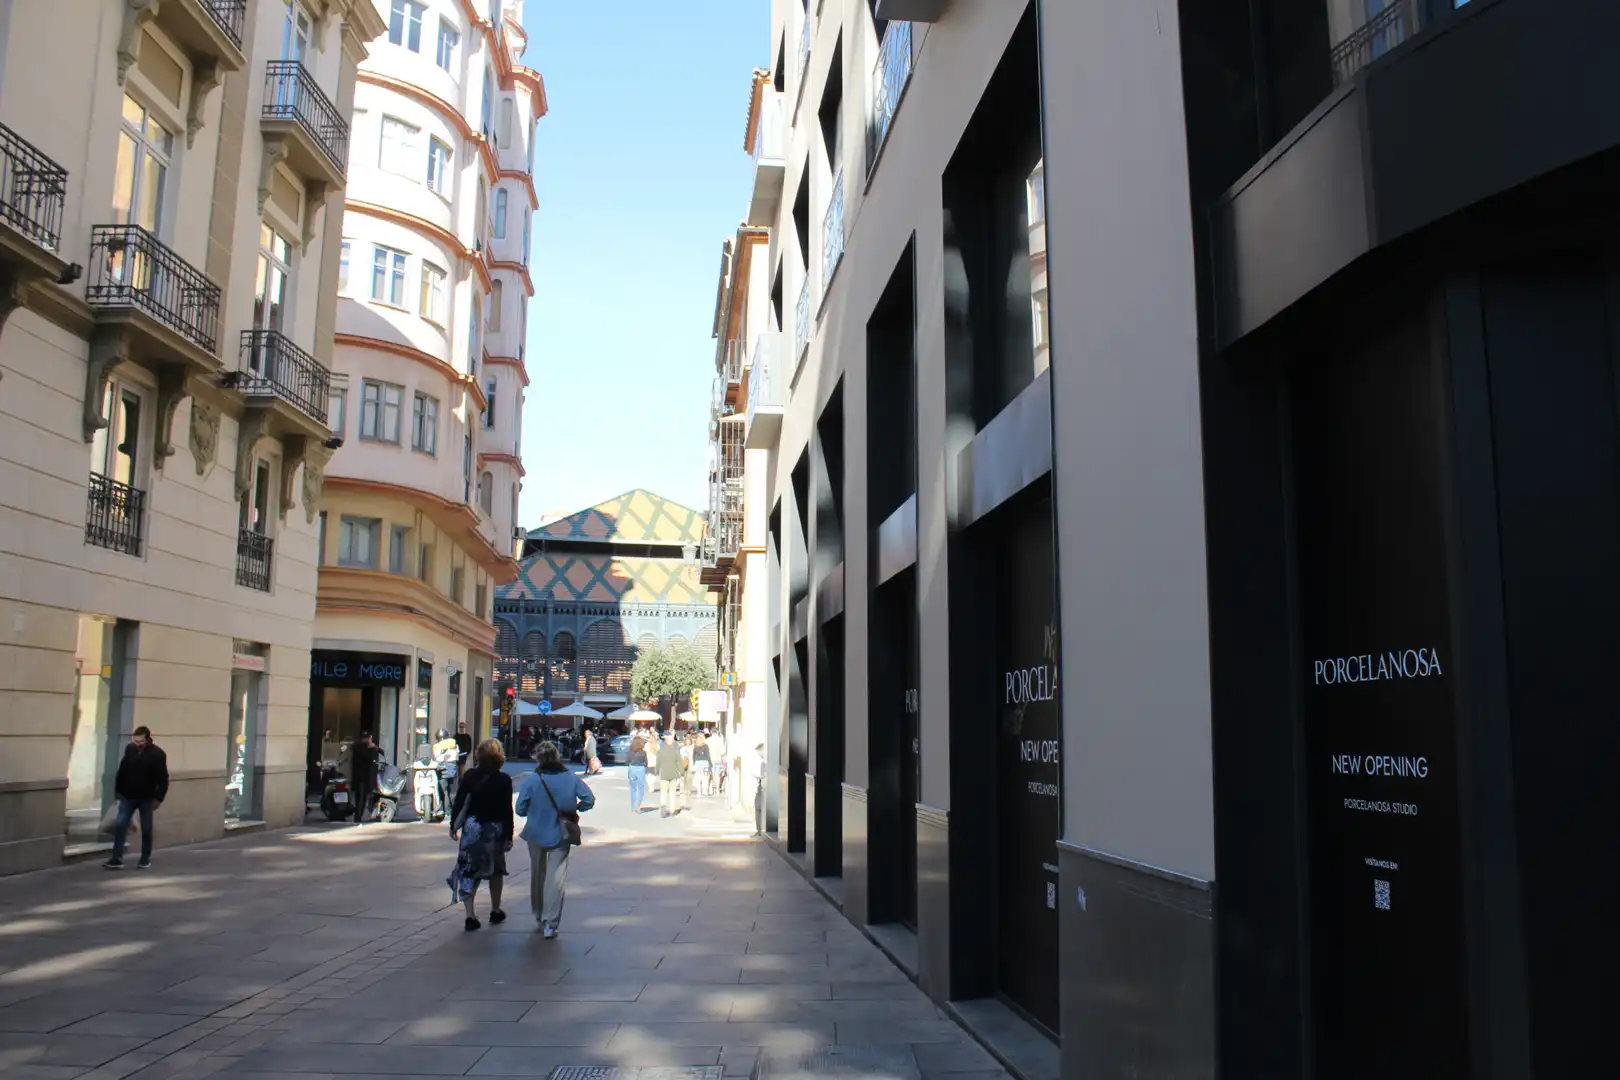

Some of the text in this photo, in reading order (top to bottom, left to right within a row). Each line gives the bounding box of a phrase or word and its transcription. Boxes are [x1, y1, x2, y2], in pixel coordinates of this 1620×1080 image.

[1314, 647, 1443, 685] PORCELANOSA
[1021, 740, 1040, 761] NEW
[1332, 754, 1429, 778] NEW OPENING
[1344, 797, 1418, 816] PORCELANOSA STUDIO
